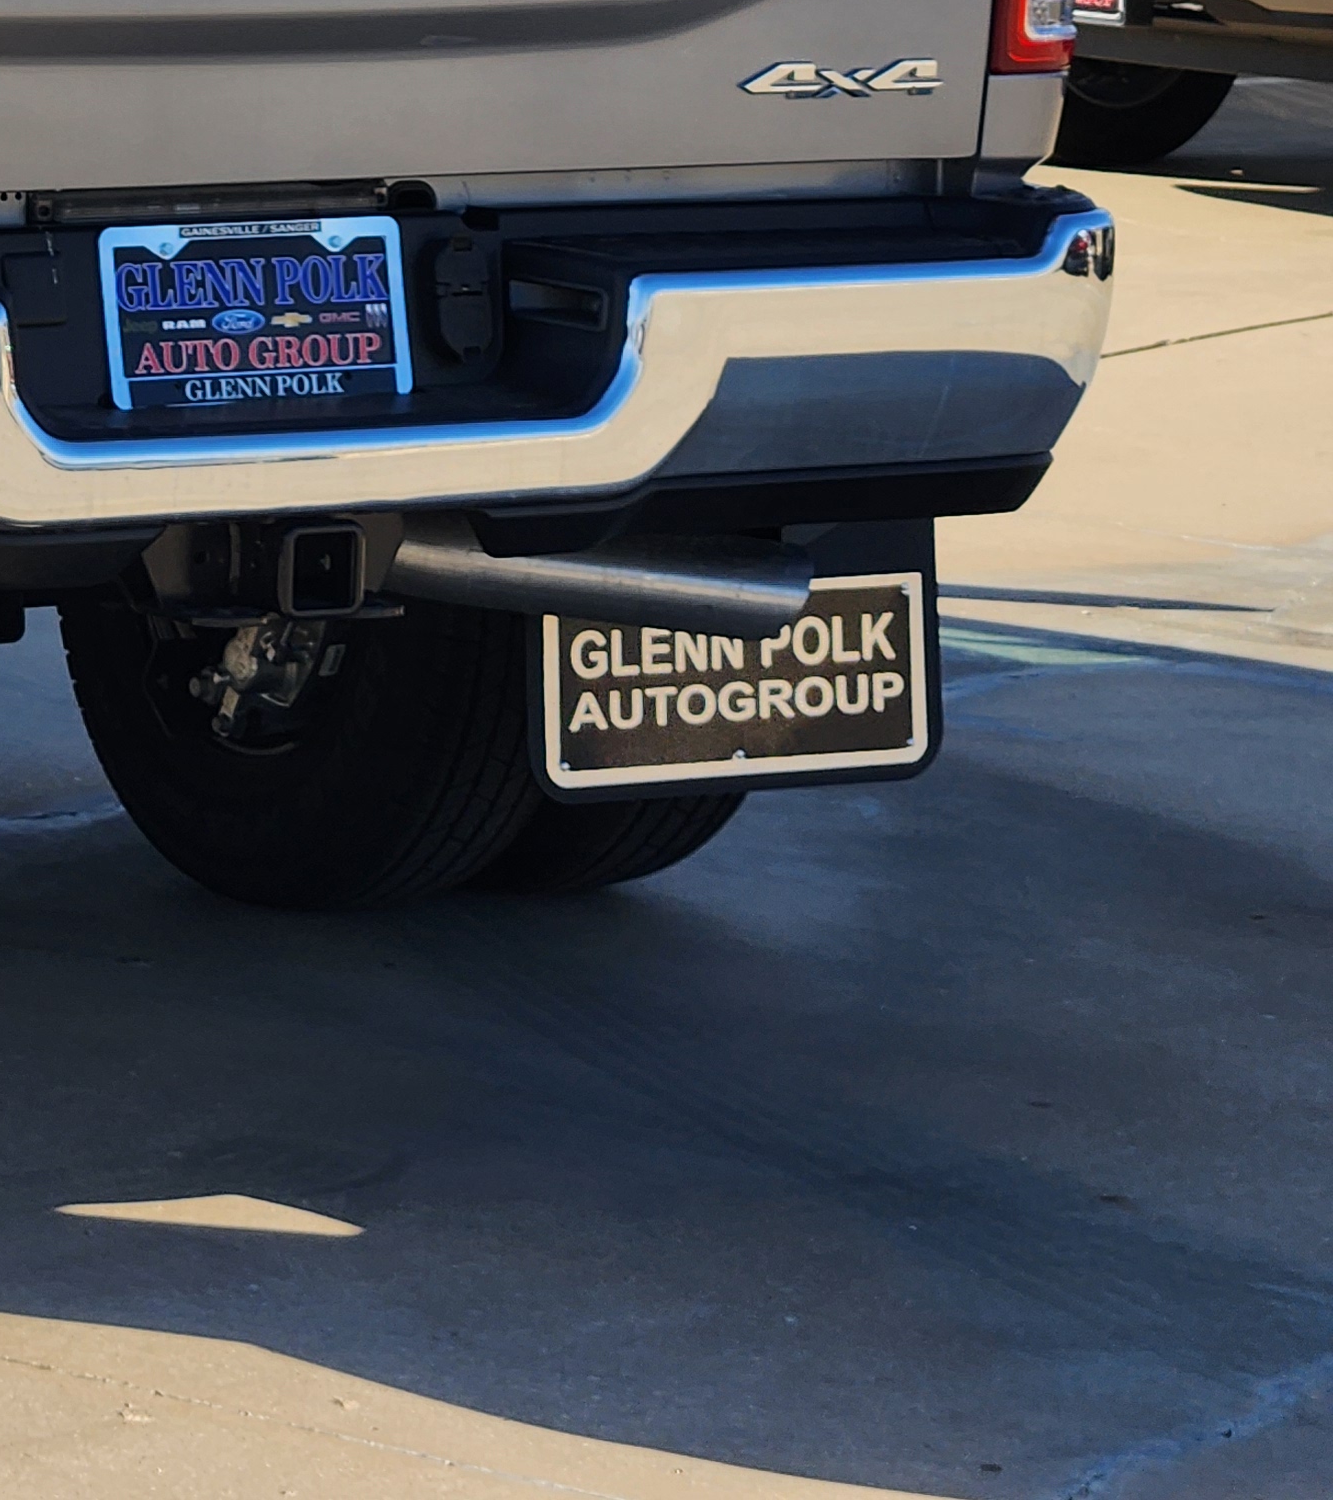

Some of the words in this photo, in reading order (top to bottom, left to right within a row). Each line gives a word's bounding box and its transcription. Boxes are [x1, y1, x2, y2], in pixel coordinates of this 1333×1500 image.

[736, 57, 944, 99] 4x4
[180, 225, 260, 238] GAINESVILLE
[270, 222, 320, 234] SANGER
[116, 257, 266, 312] GLENN
[272, 254, 389, 304] POLK
[161, 318, 207, 331] RAM
[219, 313, 256, 332] Ford
[319, 311, 361, 324] GMC
[135, 338, 240, 374] AUTO
[248, 332, 383, 369] GROUP
[184, 376, 272, 402] GLENN
[276, 372, 345, 397] POLK
[570, 627, 744, 680] GLENN
[569, 671, 905, 733] AUTOGROUP
